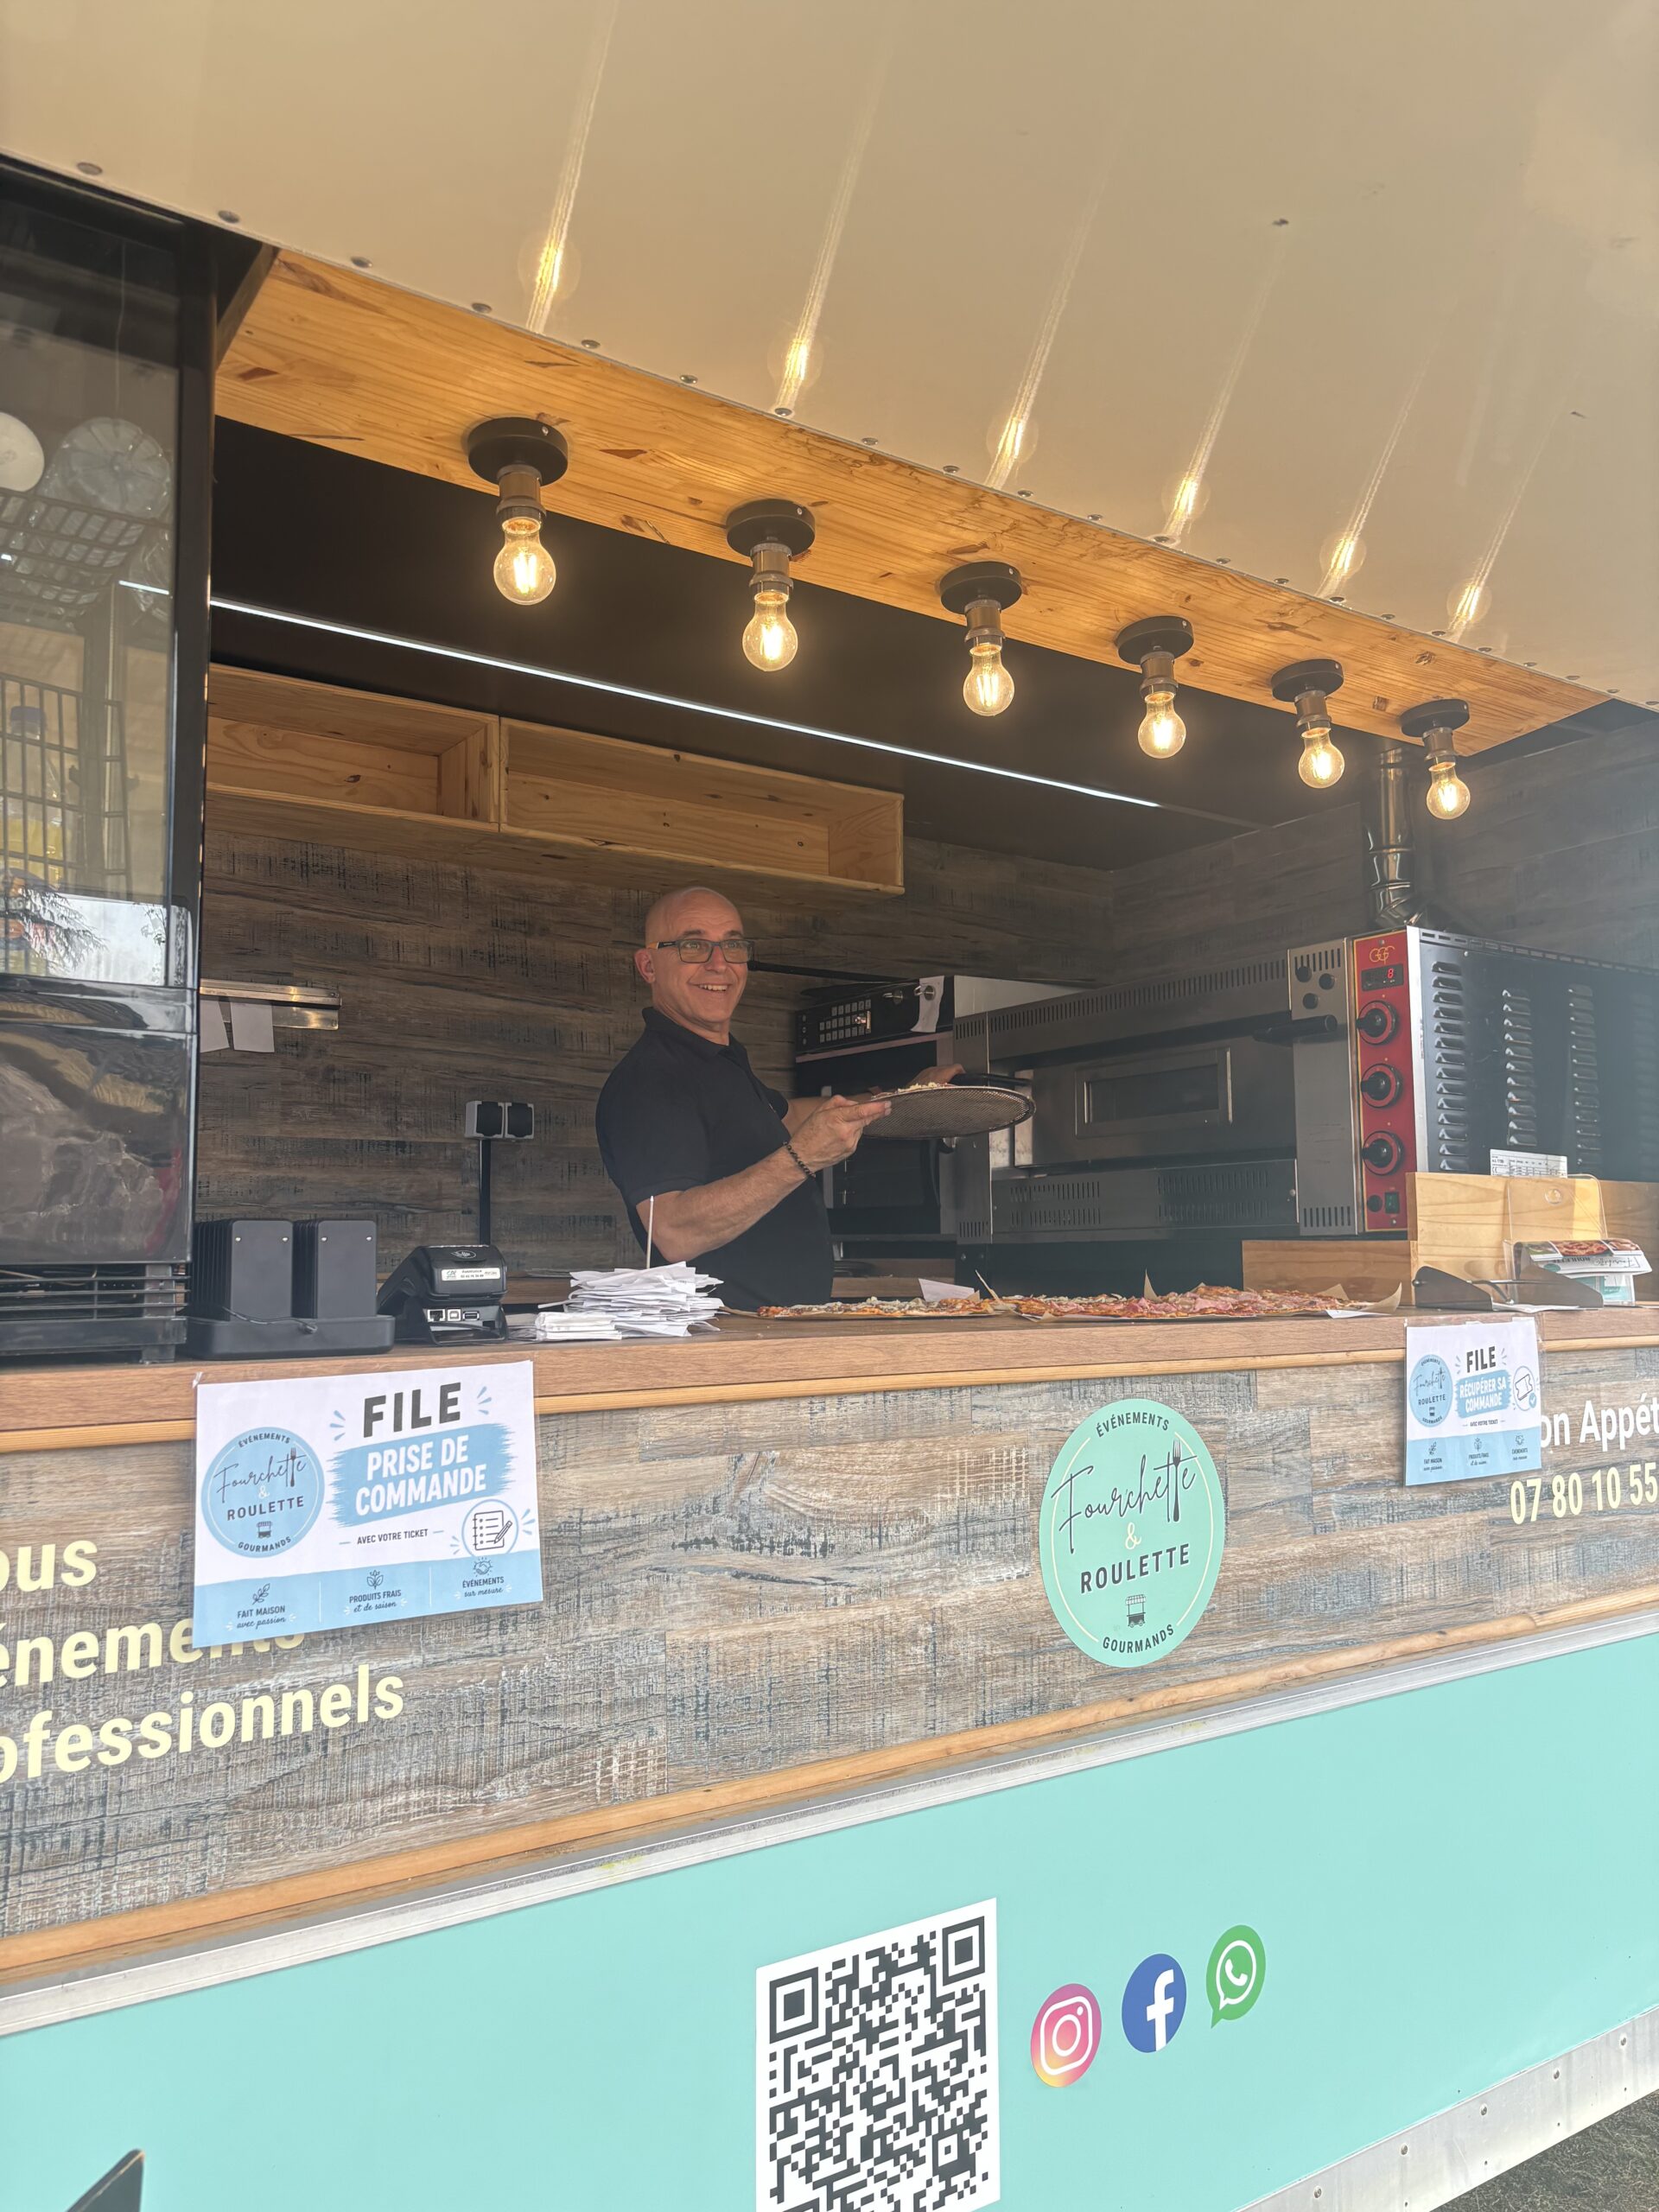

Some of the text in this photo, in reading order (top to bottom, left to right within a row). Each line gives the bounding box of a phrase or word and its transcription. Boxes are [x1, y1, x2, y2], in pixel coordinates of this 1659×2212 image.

[1466, 1346, 1496, 1373] FILE
[1459, 1376, 1507, 1399] RÉCUPÉRER SA
[364, 1382, 461, 1438] FILE
[1418, 1394, 1446, 1406] ROULETTE
[1465, 1392, 1503, 1414] COMMANDE
[1096, 1412, 1170, 1438] ÉVÉNEMENTS
[238, 1433, 291, 1448] ÉVÉNEMENTS
[367, 1434, 469, 1481] PRISE DE
[213, 1447, 307, 1503] Fourchette
[258, 1485, 270, 1498] &
[355, 1464, 487, 1516] COMMANDE
[1051, 1440, 1198, 1554] Fourchette
[1510, 1462, 1658, 1525] 07 80 10 55
[227, 1496, 304, 1521] ROULETTE
[238, 1536, 292, 1553] GOURMANDS
[357, 1529, 429, 1545] AVEC VOTRE TICKET
[1125, 1522, 1142, 1550] &
[0, 1540, 98, 1592] us
[1081, 1543, 1190, 1593] ROULETTE
[462, 1576, 505, 1589] ÉVÉNEMENTS
[477, 1586, 504, 1597] mesure
[349, 1589, 402, 1604] PRODUITS FRAIS
[353, 1601, 397, 1613] et de saison
[237, 1605, 286, 1618] FAIT MAISON
[256, 1616, 286, 1630] passion
[1103, 1624, 1175, 1655] GOURMANDS
